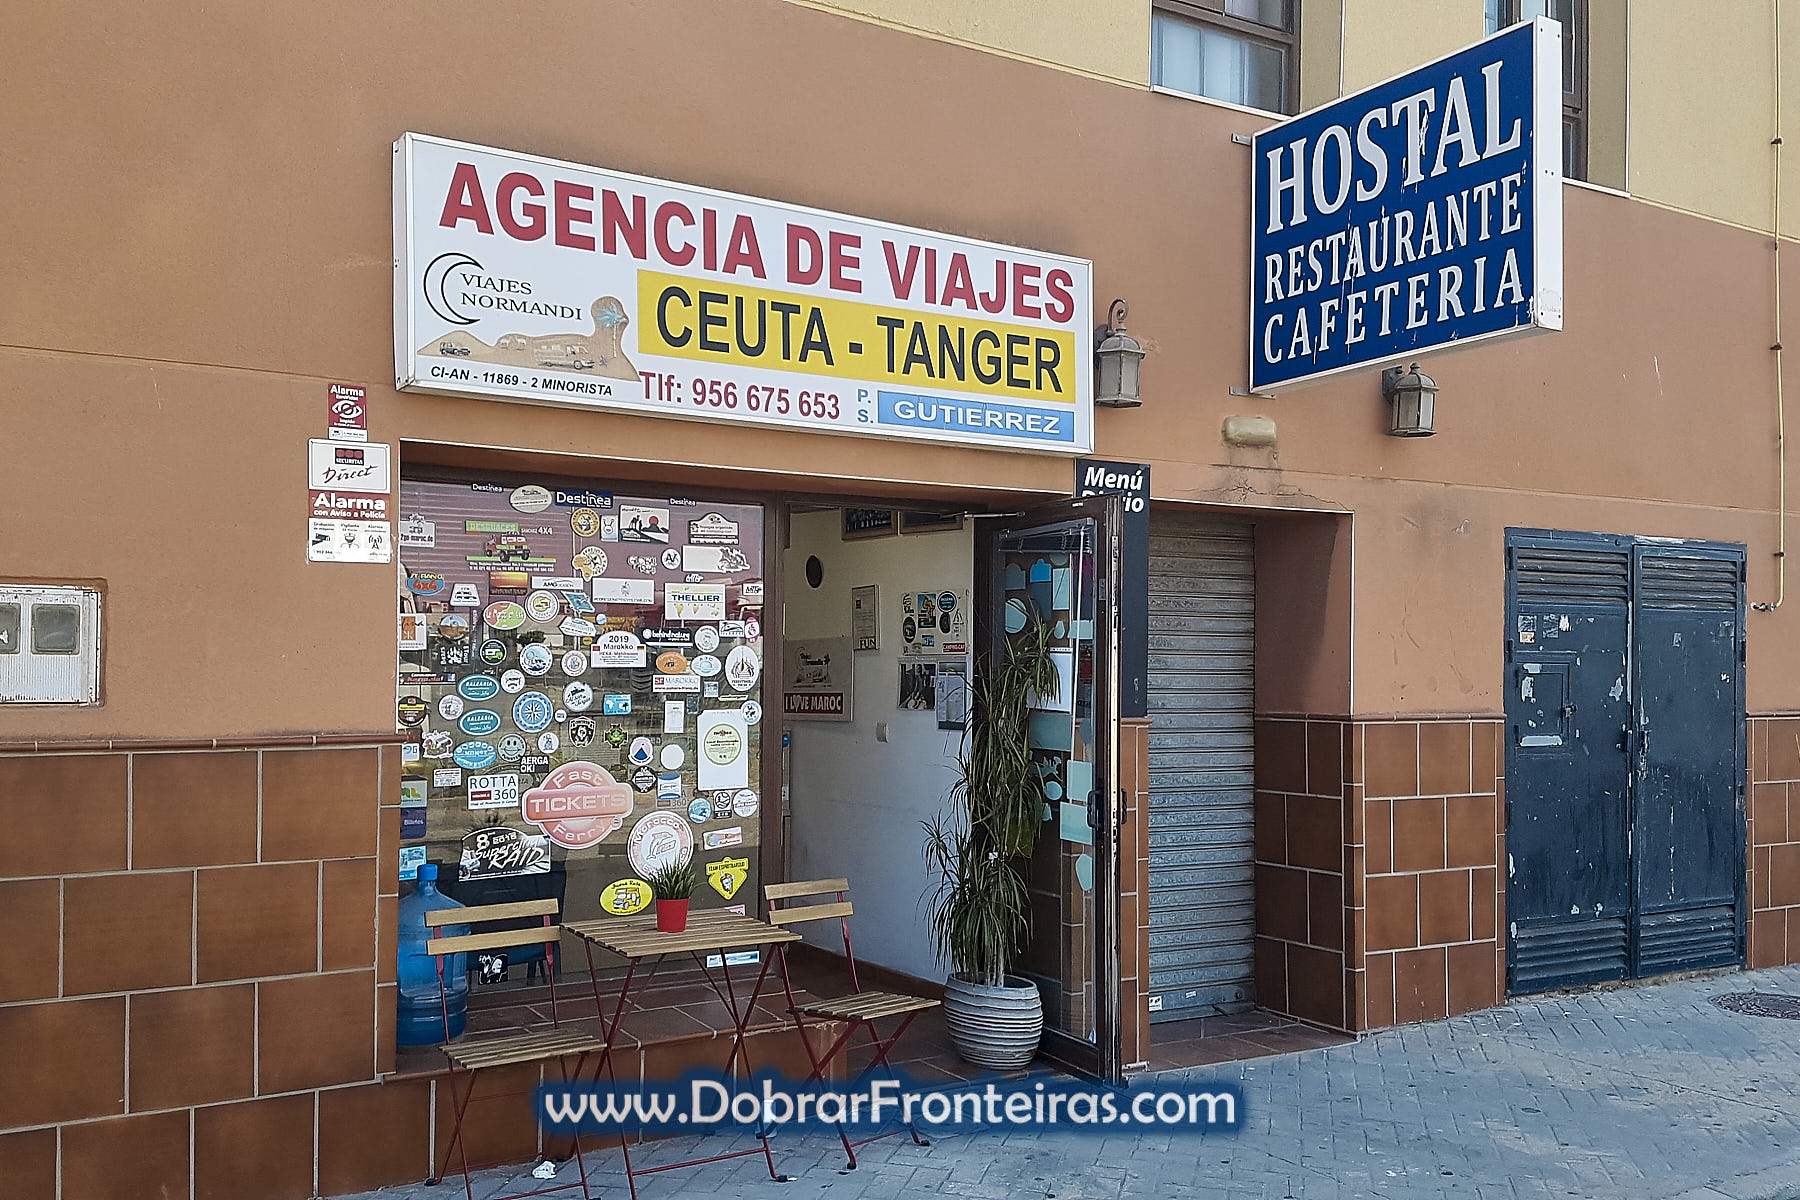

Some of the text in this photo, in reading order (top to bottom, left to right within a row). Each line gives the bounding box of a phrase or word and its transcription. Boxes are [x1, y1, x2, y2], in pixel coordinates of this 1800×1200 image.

[1266, 60, 1522, 235] HOSTAL
[438, 162, 1075, 324] AGENCIA DE VIAJES
[1265, 172, 1522, 304] RESTAURANTE
[459, 272, 533, 296] VIAJES
[460, 291, 583, 321] NORMANDI
[1264, 247, 1525, 364] CAFETERIA
[656, 285, 835, 367] CEUTA
[876, 315, 1063, 394] TANGER
[330, 384, 365, 397] Alarma
[430, 365, 470, 382] CI-AN
[483, 371, 520, 387] 11869
[531, 377, 539, 389] 2
[541, 378, 613, 397] MINORISTA
[639, 370, 840, 420] Tlf: 956 675 653
[893, 400, 1061, 435] GUTIERREZ
[321, 465, 380, 485] Direct
[1084, 466, 1144, 491] Menú
[313, 492, 387, 512] Alarma
[556, 490, 612, 508] Destinea
[313, 509, 329, 517] con
[329, 509, 352, 518] Aviso
[671, 594, 720, 602] THELLIER
[608, 635, 629, 643] 2019
[859, 638, 876, 649] FUN
[811, 694, 842, 711] MAROC
[520, 756, 549, 765] AERGA
[520, 764, 535, 773] OKI
[470, 776, 517, 790] ROTTA
[493, 788, 517, 800] 360
[529, 793, 626, 813] TICKETS
[552, 822, 605, 841] Ferry
